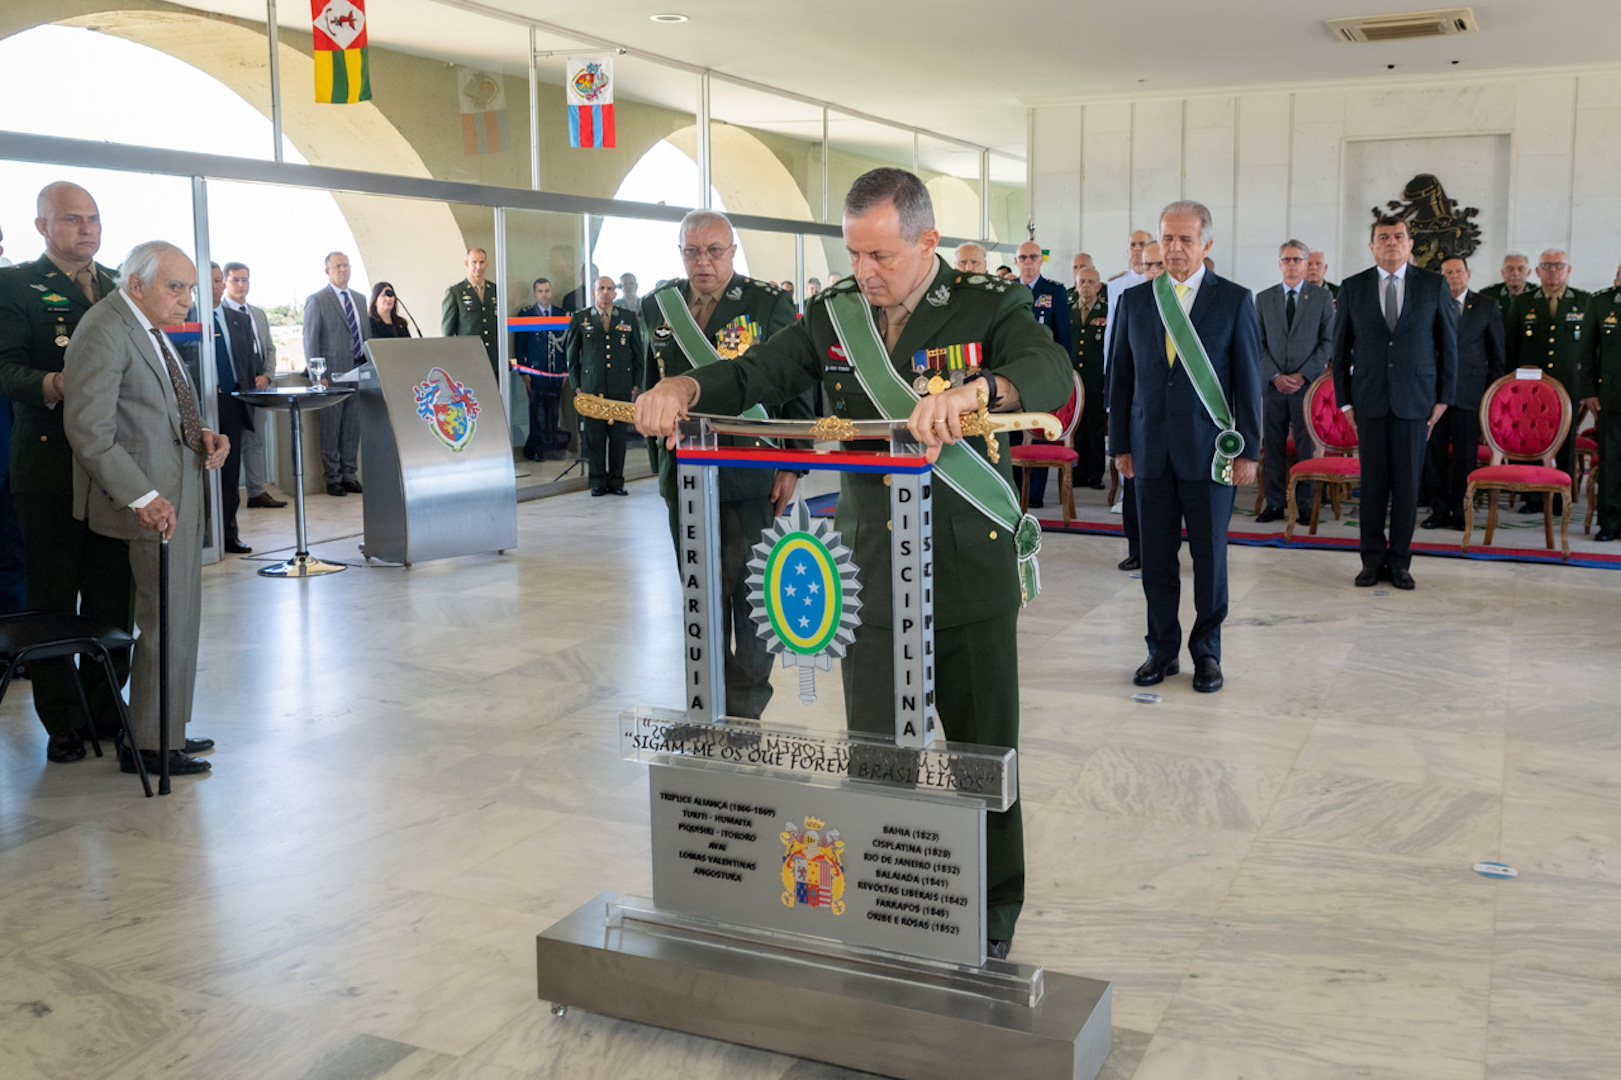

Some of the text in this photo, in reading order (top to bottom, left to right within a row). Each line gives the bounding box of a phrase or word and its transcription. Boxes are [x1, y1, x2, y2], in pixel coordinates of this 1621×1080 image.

[683, 475, 703, 710] HIERARQUIA
[898, 487, 916, 737] DISCIPLINA
[720, 746, 743, 761] OS
[748, 749, 783, 766] QUE
[790, 752, 851, 775] FOREM
[882, 826, 911, 837] BAHIA
[872, 839, 922, 854] CISPLATINA
[679, 851, 757, 871] LOMAS VALENTINAS
[863, 853, 879, 862] RIO
[881, 855, 892, 864] DE
[894, 857, 931, 870] JANEIRO
[693, 867, 742, 882] ANGOSTURA
[875, 869, 920, 883] BALAIADA
[857, 881, 968, 907] REVOLTAS LIBERAIS (1842)
[876, 898, 921, 913] FARRAPOS
[894, 916, 899, 925] E
[901, 917, 929, 930] ROSAS
[931, 923, 960, 936] (1852)
